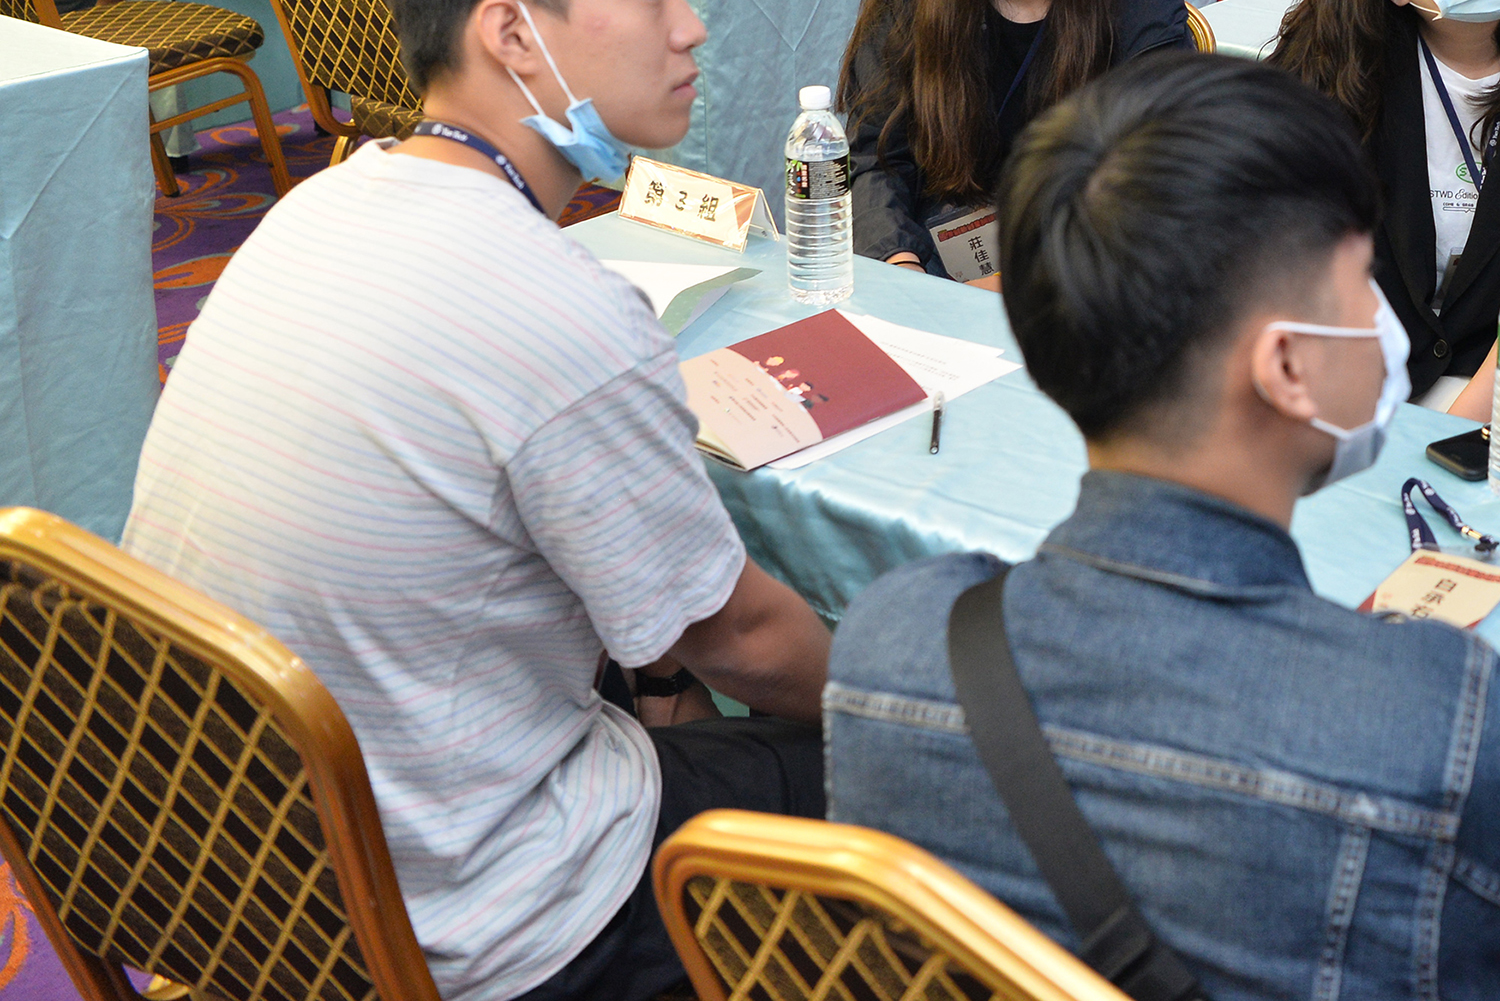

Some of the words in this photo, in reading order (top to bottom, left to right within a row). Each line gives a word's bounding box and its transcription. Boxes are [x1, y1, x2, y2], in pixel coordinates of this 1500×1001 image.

[1429, 190, 1453, 198] STWD
[968, 236, 994, 276] 莊佳慧
